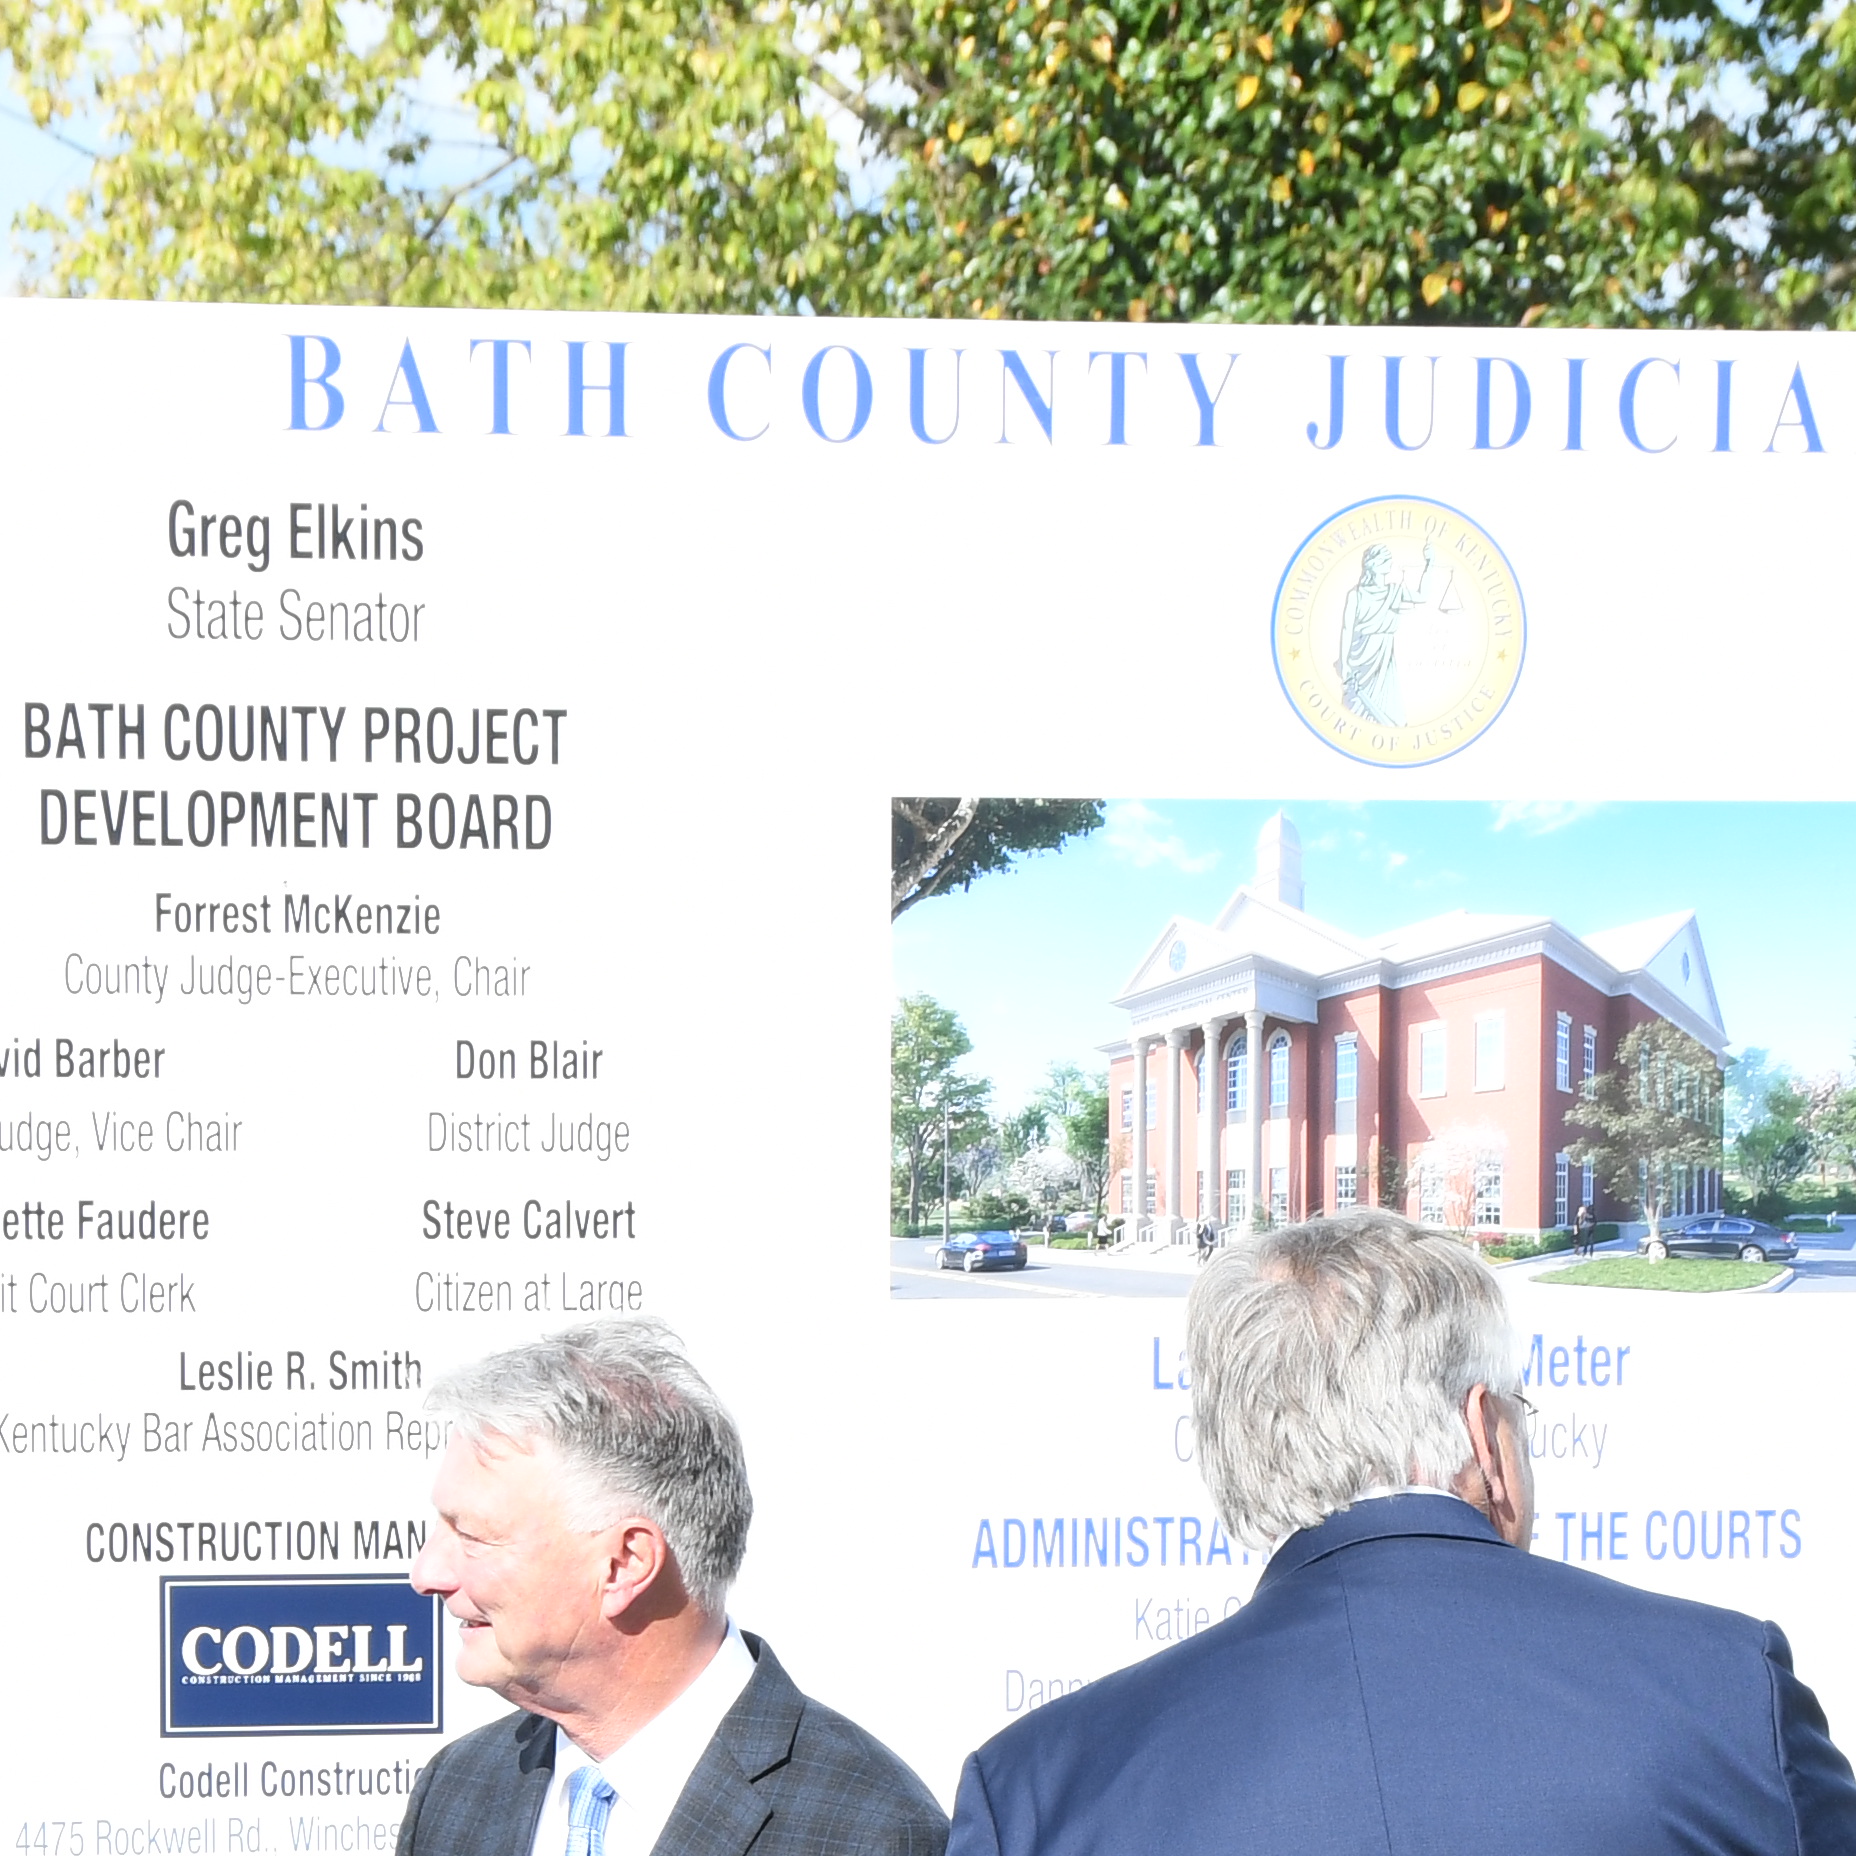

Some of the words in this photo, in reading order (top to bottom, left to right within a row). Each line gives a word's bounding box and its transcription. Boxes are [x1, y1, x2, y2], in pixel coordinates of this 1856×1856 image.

[282, 333, 633, 438] BATH
[707, 341, 1241, 448] COUNTY
[168, 498, 271, 573] Greg
[289, 501, 424, 562] Elkins
[167, 585, 264, 641] State
[279, 587, 426, 643] Senator
[24, 701, 146, 761] BATH
[163, 702, 347, 763] COUNTY
[364, 706, 568, 766] PROJECT
[40, 788, 379, 849] DEVELOPMENT
[396, 791, 552, 851] BOARD
[155, 892, 272, 934] Forrest
[284, 893, 441, 935] McKenzie
[64, 952, 169, 1005] County
[180, 954, 439, 1006] Judge-Executive,
[453, 955, 531, 997] Chair
[55, 1037, 166, 1079] Barber
[456, 1039, 516, 1080] Don
[529, 1039, 604, 1080] Blair
[91, 1110, 154, 1153] Vice
[166, 1110, 243, 1153] Chair
[428, 1111, 531, 1153] District
[540, 1111, 630, 1162] Judge
[77, 1199, 210, 1241] Faudere
[422, 1198, 511, 1240] Steve
[523, 1198, 636, 1240] Calvert
[29, 1271, 109, 1314] Court
[120, 1271, 197, 1314] Clerk
[415, 1271, 512, 1313] Citizen
[523, 1272, 552, 1312] at
[562, 1271, 643, 1314] Large
[179, 1350, 274, 1392] Leslie
[286, 1350, 316, 1391] R.
[328, 1349, 422, 1391] Smith
[143, 1412, 194, 1453] Bar
[201, 1411, 372, 1453] Association
[85, 1520, 339, 1564] CONSTRUCTION
[354, 1520, 426, 1560] MAN
[1555, 1511, 1628, 1561] THE
[1645, 1508, 1802, 1561] COURTS
[1136, 1598, 1210, 1640] Katie
[181, 1625, 424, 1676] CODELL
[181, 1675, 271, 1685] CONSTRUCTION
[274, 1674, 354, 1684] MANAGEMENT
[359, 1673, 392, 1683] SINCE
[159, 1761, 248, 1800] Codell
[261, 1759, 424, 1797] Constructi
[15, 1821, 84, 1856] 4475
[96, 1817, 216, 1856] Rockwell
